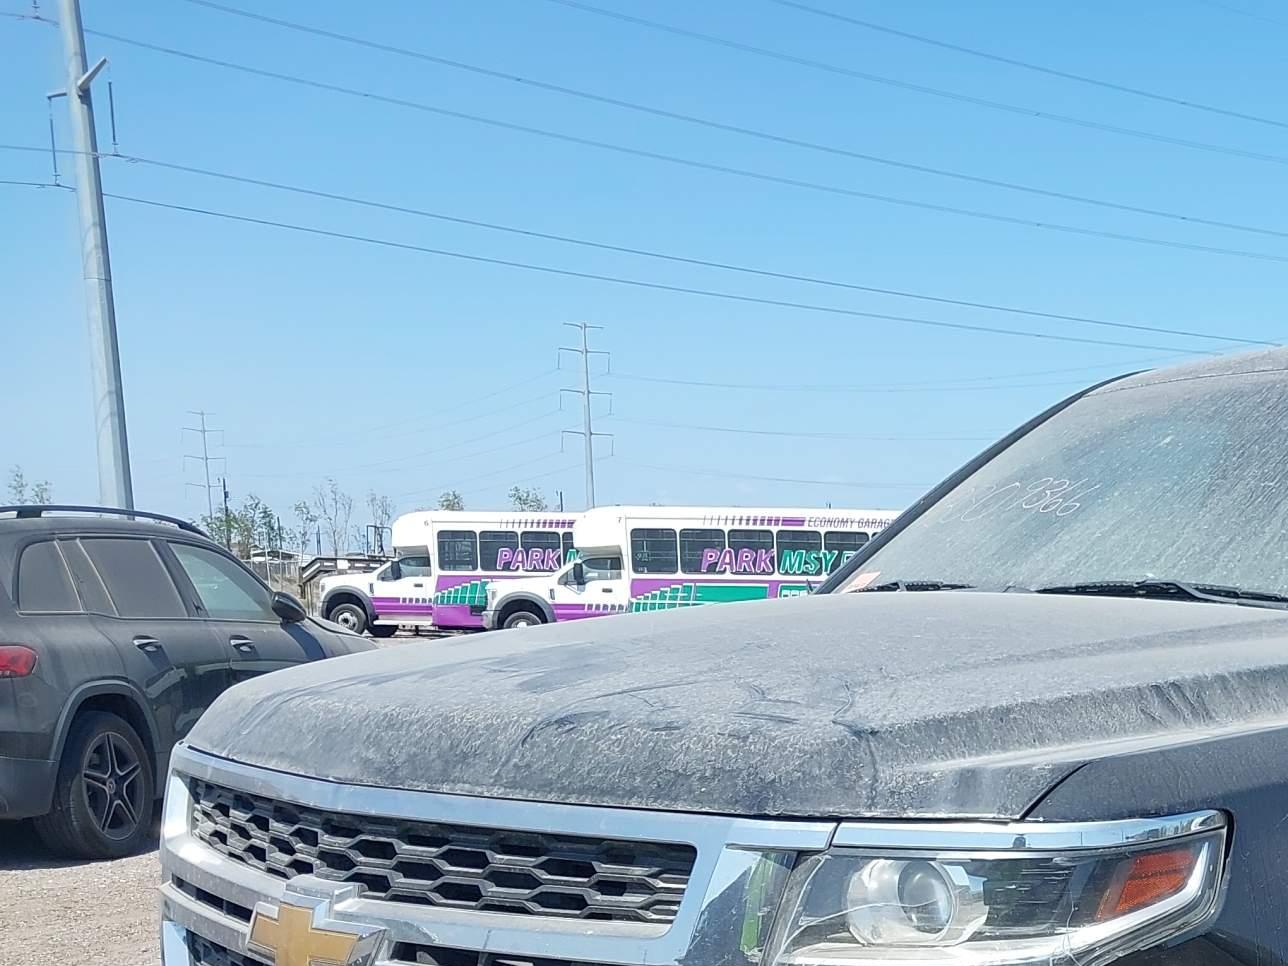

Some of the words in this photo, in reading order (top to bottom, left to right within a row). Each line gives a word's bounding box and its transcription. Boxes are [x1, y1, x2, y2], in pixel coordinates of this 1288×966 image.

[807, 516, 856, 529] ECONOMY
[857, 517, 896, 529] GARAG
[496, 547, 562, 571] PARK
[700, 547, 776, 574] PARK
[779, 549, 839, 575] MSY
